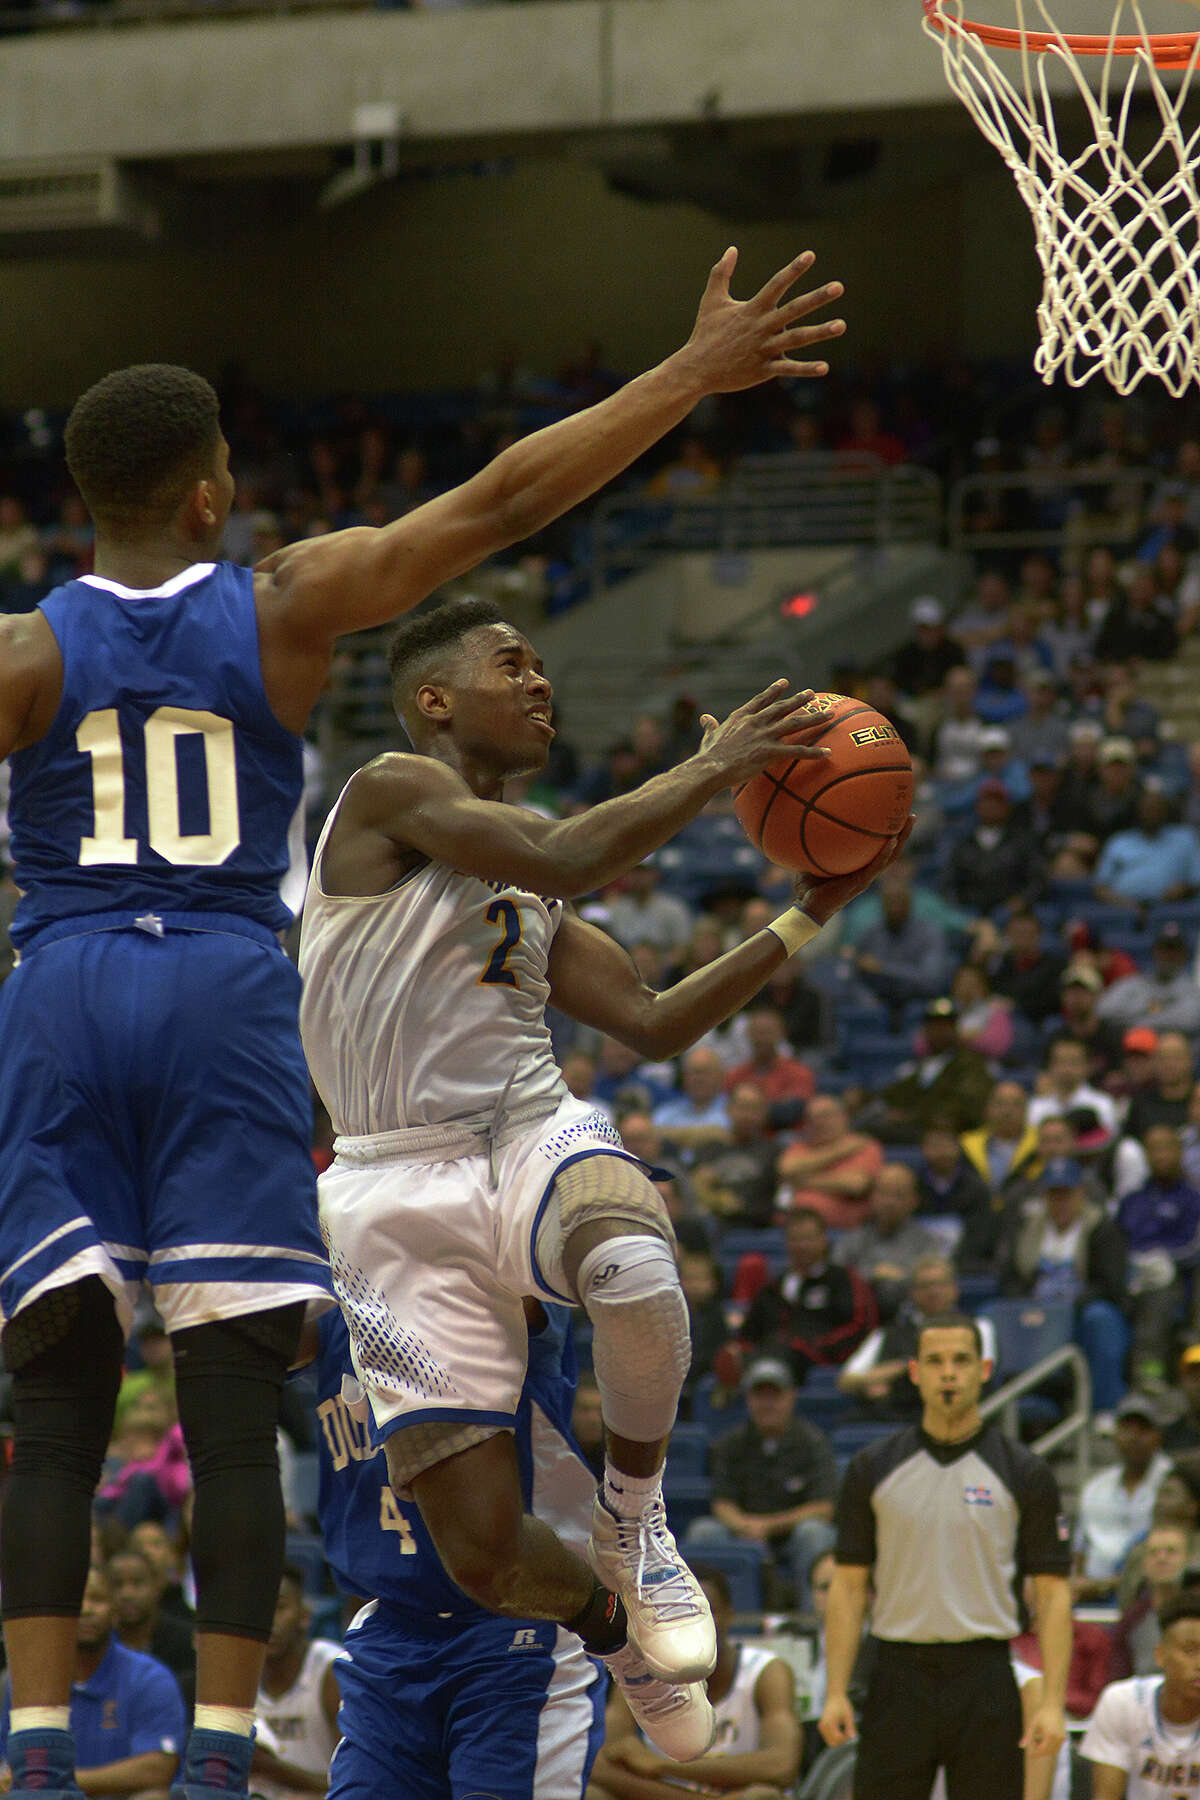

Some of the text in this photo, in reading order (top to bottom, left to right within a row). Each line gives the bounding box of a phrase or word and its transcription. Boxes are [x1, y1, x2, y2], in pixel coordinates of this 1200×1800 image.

[75, 706, 240, 866] 10
[476, 896, 524, 989] 2
[379, 1486, 418, 1555] 4
